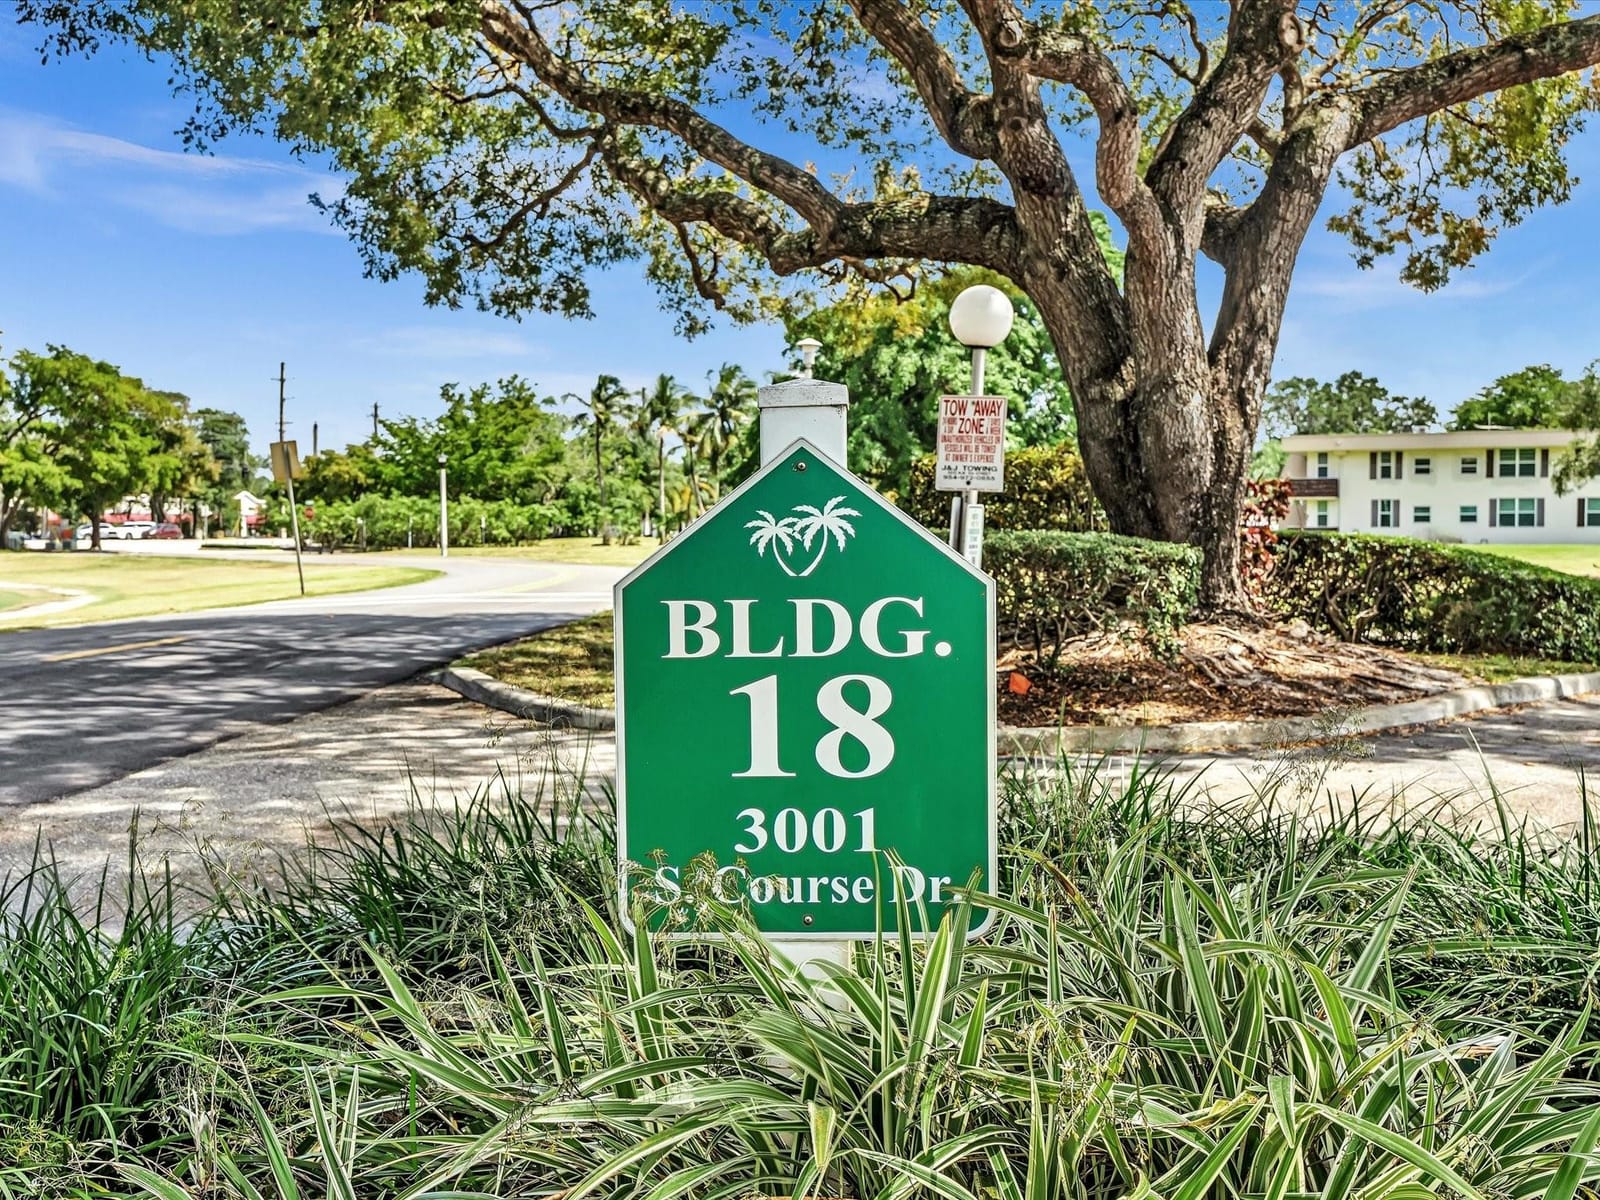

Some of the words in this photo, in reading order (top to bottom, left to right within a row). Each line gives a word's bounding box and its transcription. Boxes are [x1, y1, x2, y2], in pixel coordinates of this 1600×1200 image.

[944, 400, 968, 416] TOW
[974, 400, 1003, 416] AWAY
[958, 418, 985, 434] ZONE
[941, 435, 973, 444] UNAUTHORIZED
[974, 436, 994, 444] VEHICLES
[964, 444, 973, 452] WILL
[975, 445, 980, 453] BE
[982, 445, 996, 454] TOWED
[946, 454, 950, 462] AT
[974, 454, 994, 463] EXPENSE
[660, 595, 952, 659] BLDG.
[729, 674, 895, 779] 18
[734, 807, 882, 854] 3001
[712, 866, 875, 904] Course
[888, 866, 963, 904] Dr.
